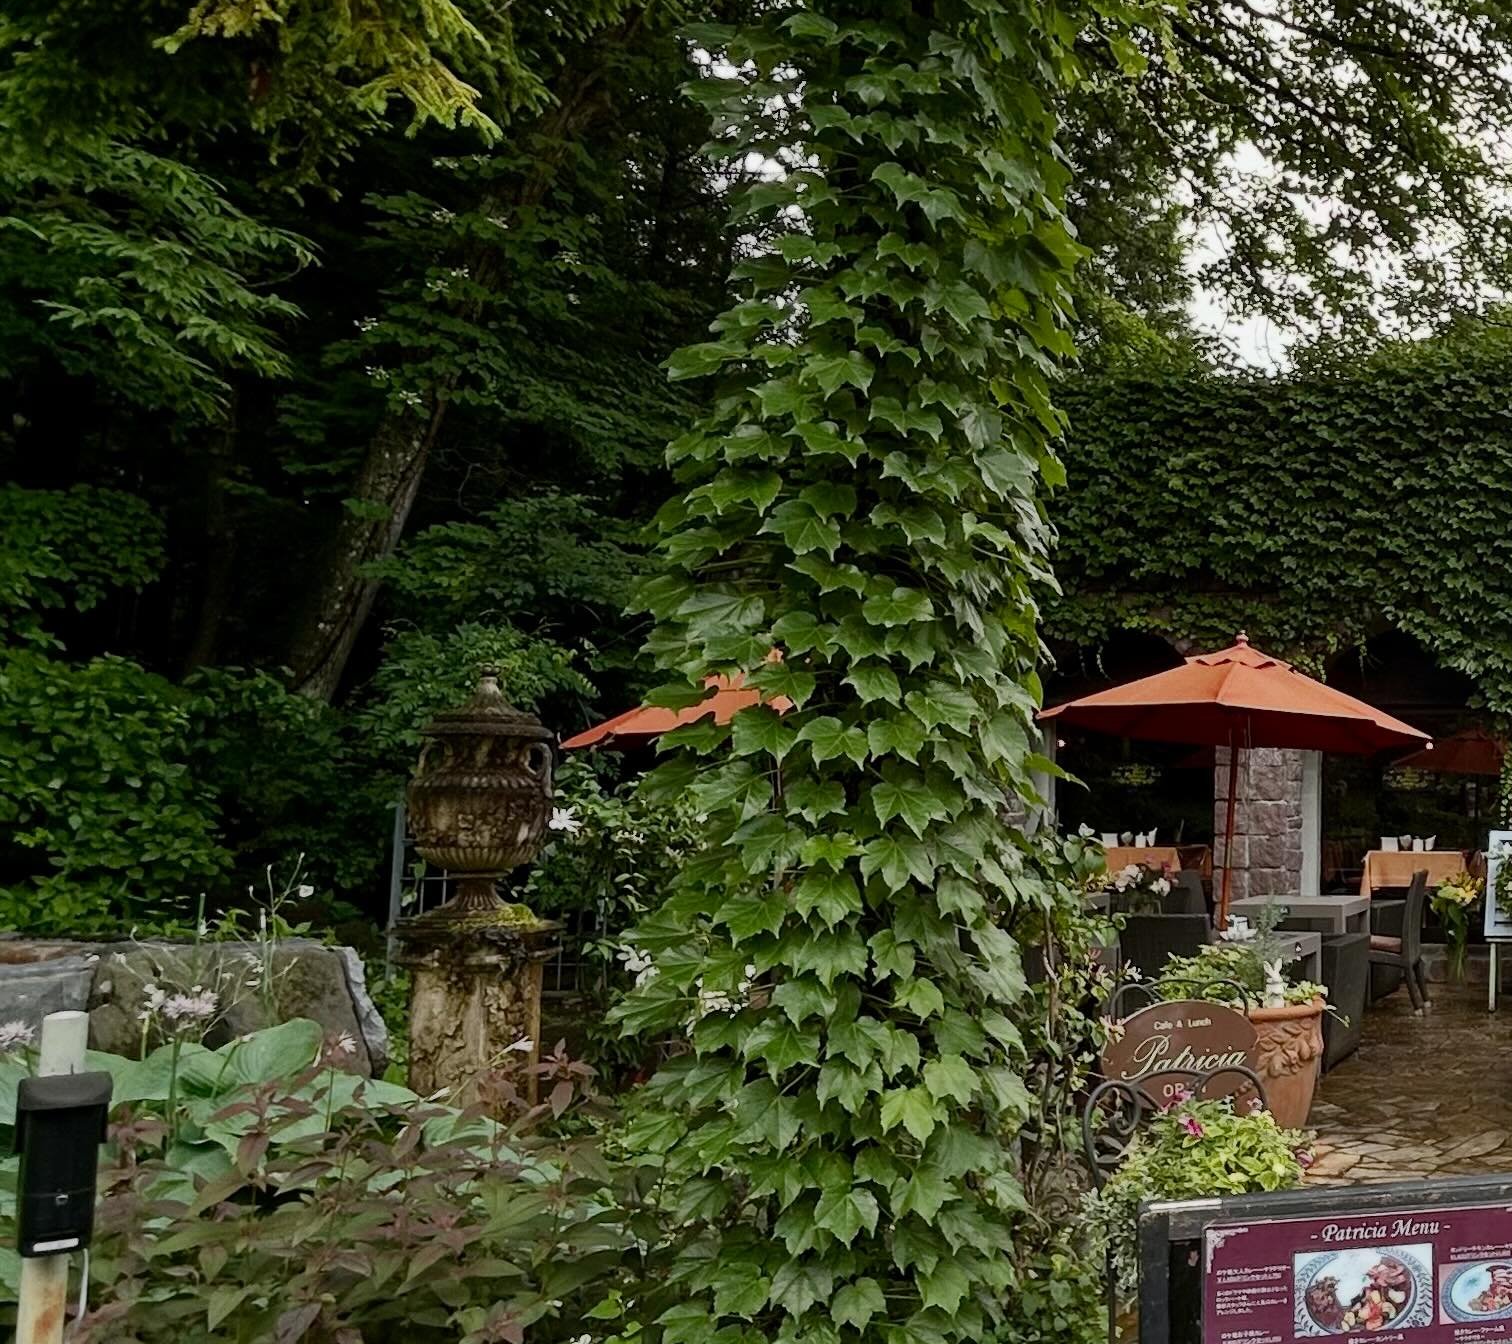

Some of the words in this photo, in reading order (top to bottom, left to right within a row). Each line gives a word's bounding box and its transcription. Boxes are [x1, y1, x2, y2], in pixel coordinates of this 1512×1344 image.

[1121, 1034, 1247, 1080] Patricia
[1322, 1221, 1387, 1243] Patricia
[1391, 1218, 1440, 1238] Menu
